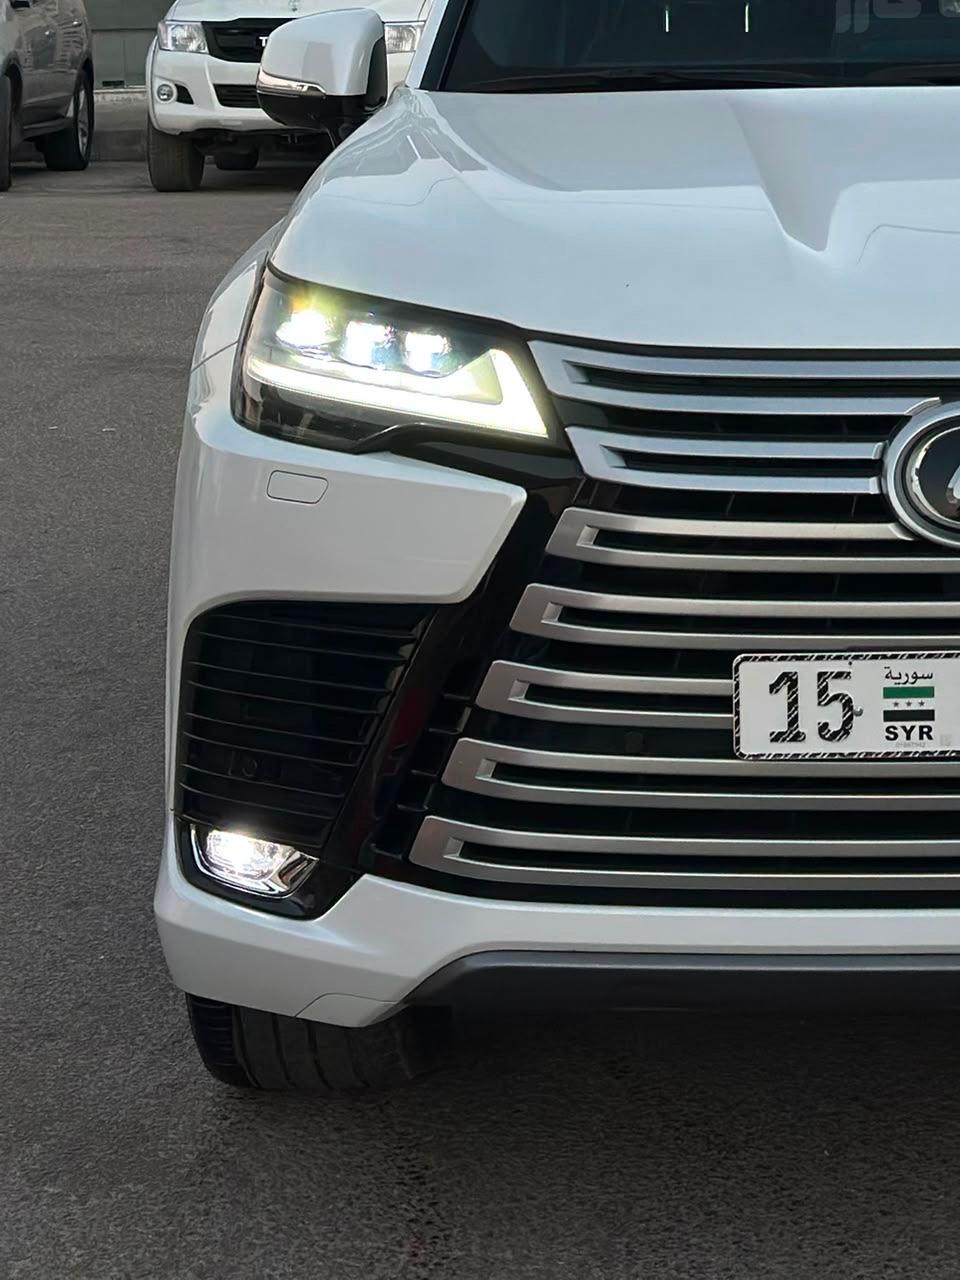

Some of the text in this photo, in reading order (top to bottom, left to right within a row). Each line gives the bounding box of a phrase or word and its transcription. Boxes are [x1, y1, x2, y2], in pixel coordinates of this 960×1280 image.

[883, 666, 934, 684] سورية
[768, 670, 855, 743] 15
[884, 724, 934, 742] SYR
